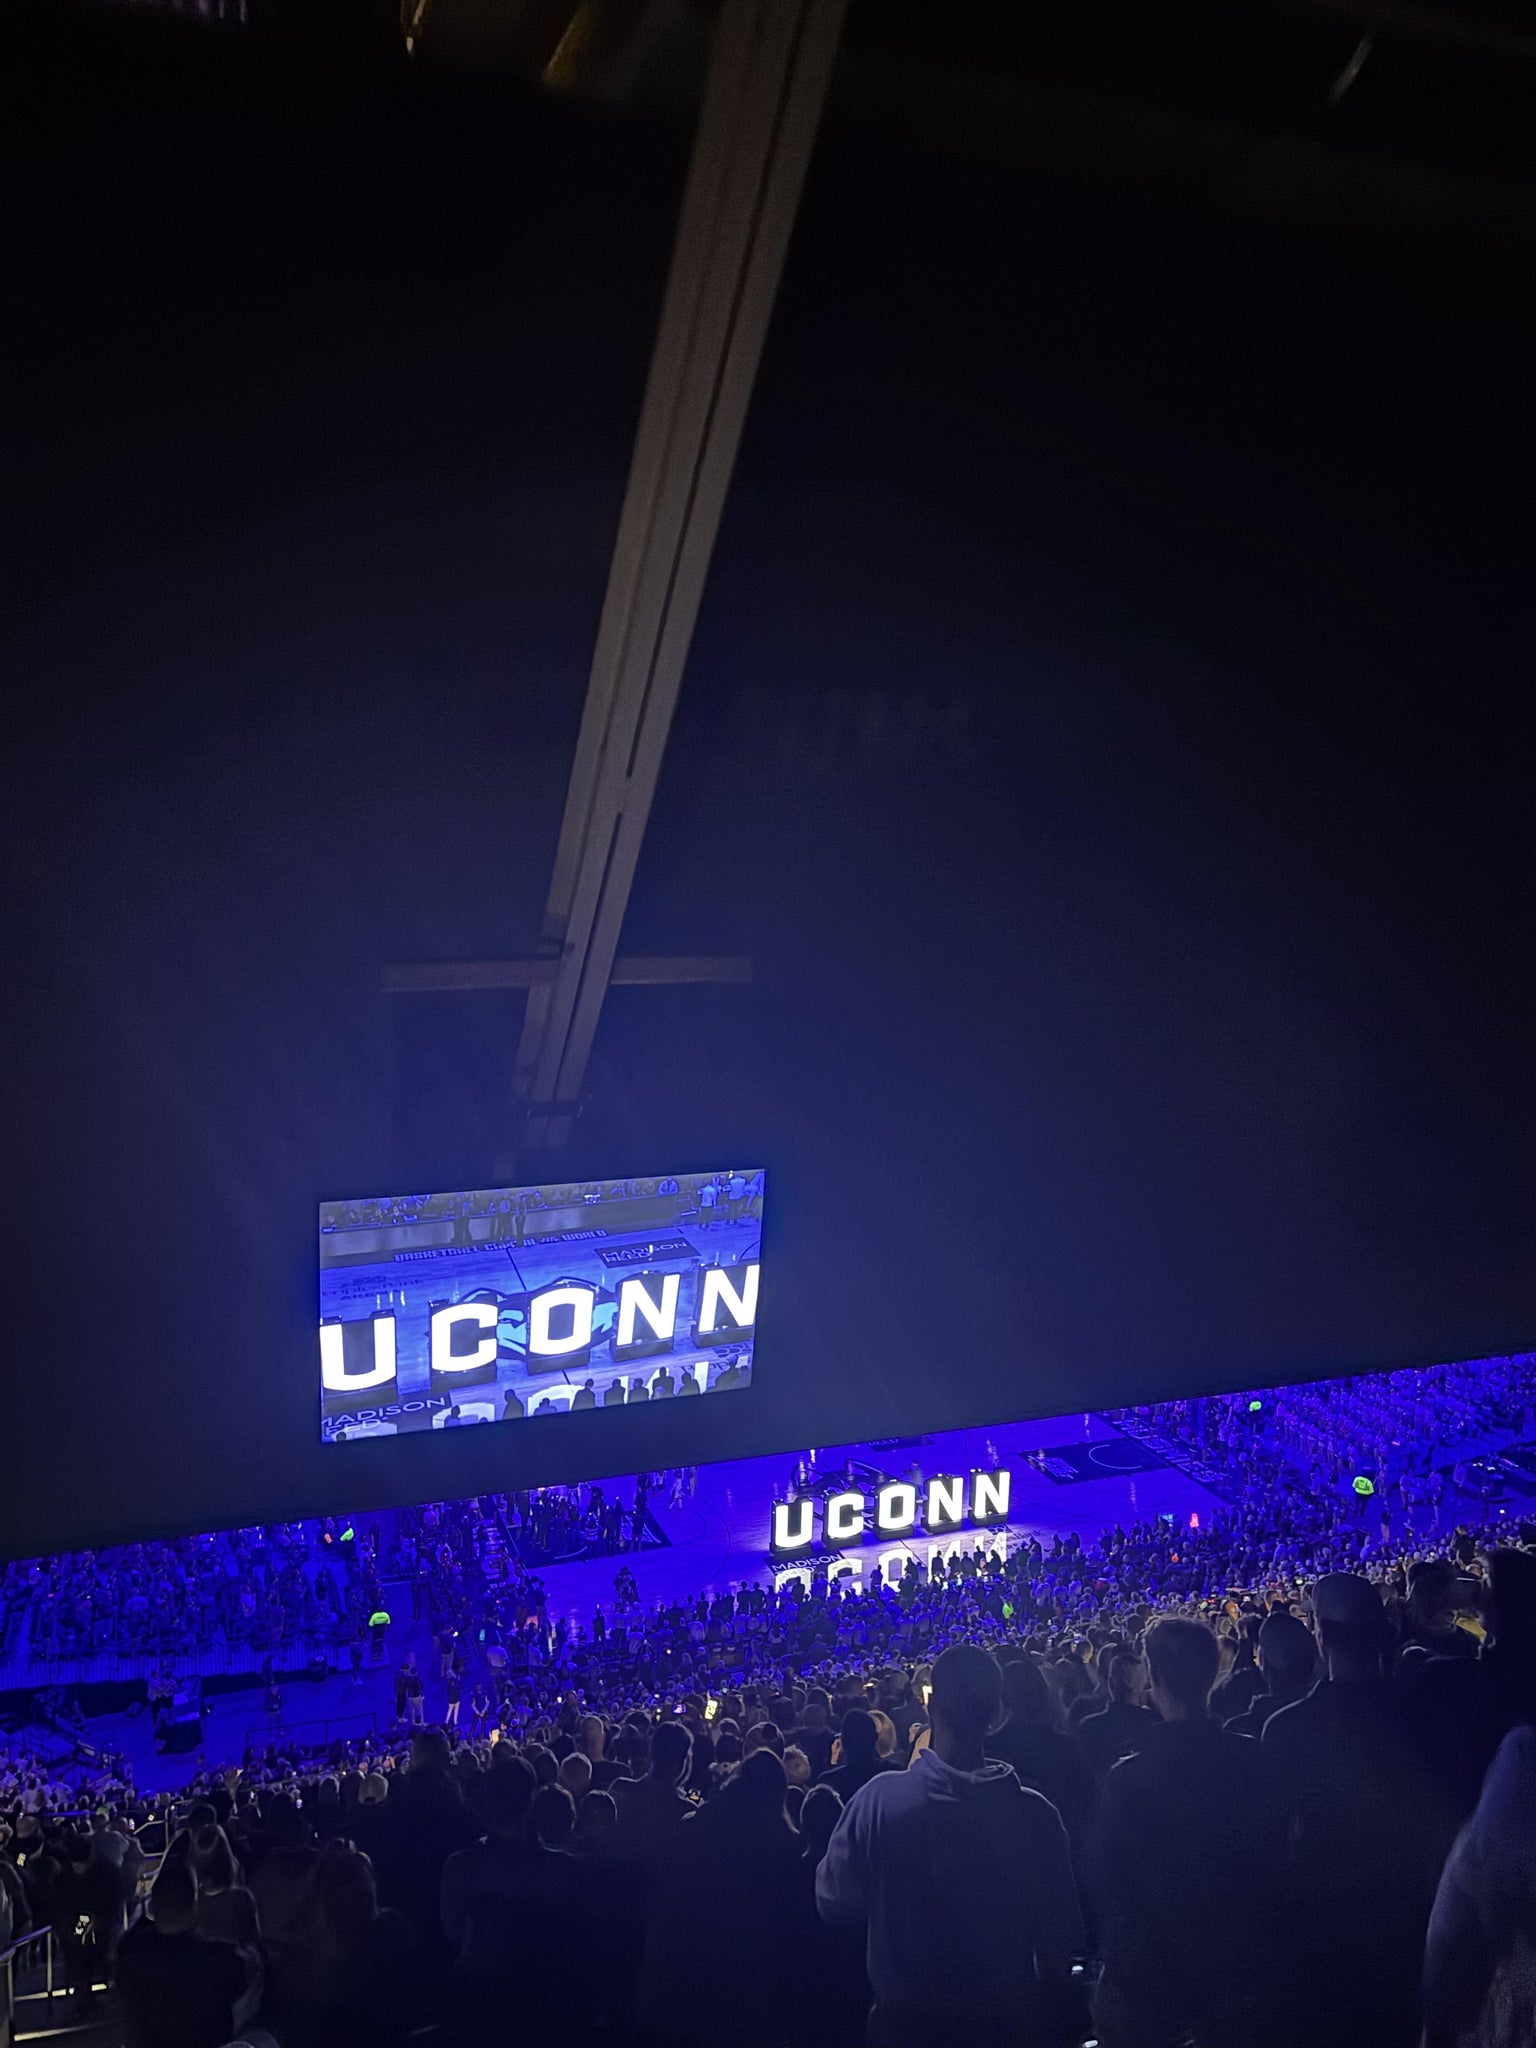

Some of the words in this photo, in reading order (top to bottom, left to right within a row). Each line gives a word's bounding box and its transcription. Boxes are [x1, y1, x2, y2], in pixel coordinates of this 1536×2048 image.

[319, 1264, 760, 1391] UCONN
[775, 1471, 1010, 1548] UCONN
[772, 1554, 842, 1572] MADISON
